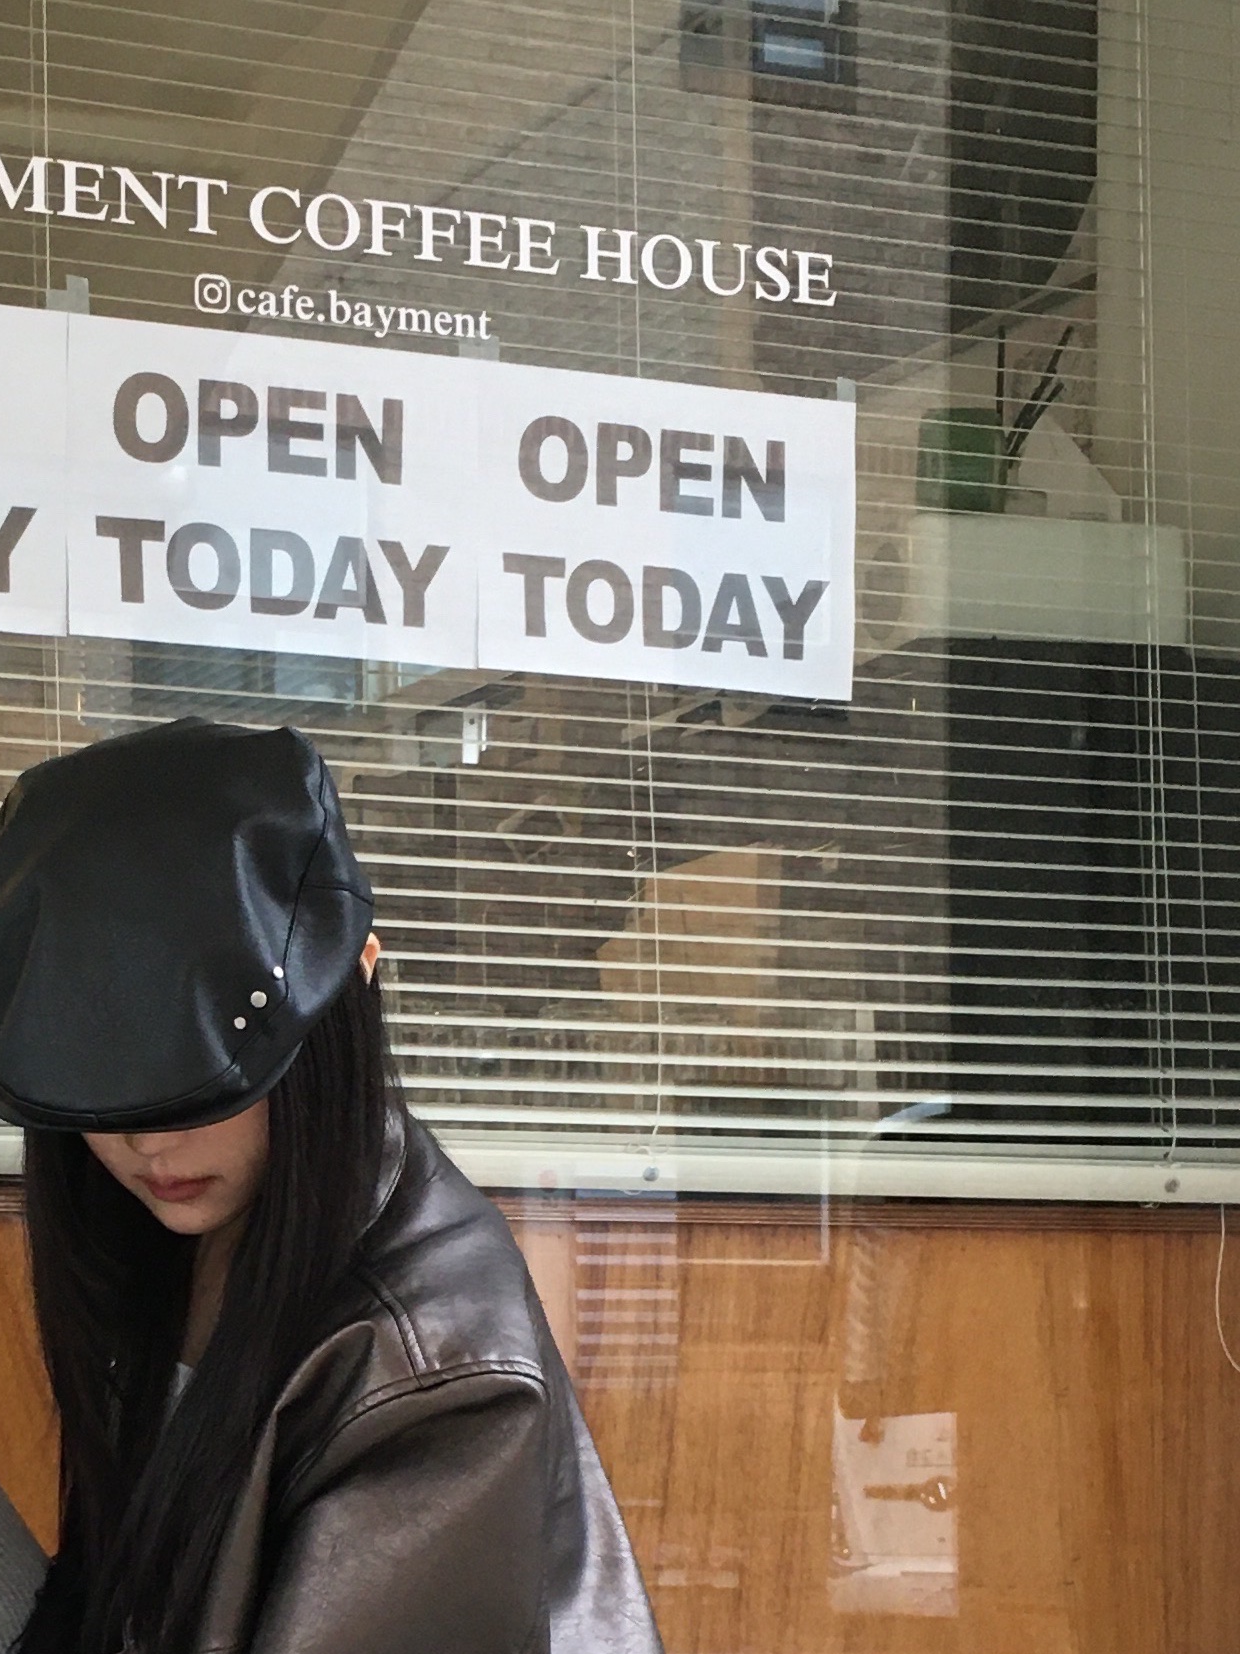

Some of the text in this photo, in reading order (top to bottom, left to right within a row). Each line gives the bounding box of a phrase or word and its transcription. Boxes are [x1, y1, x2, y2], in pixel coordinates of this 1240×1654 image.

[249, 186, 560, 275] COFFEE
[580, 225, 838, 307] HOUSE
[237, 285, 491, 340] cafe.bayment
[112, 372, 404, 486] OPEN
[518, 415, 786, 523] OPEN
[95, 515, 451, 629] TODAY
[502, 552, 830, 662] TODAY
